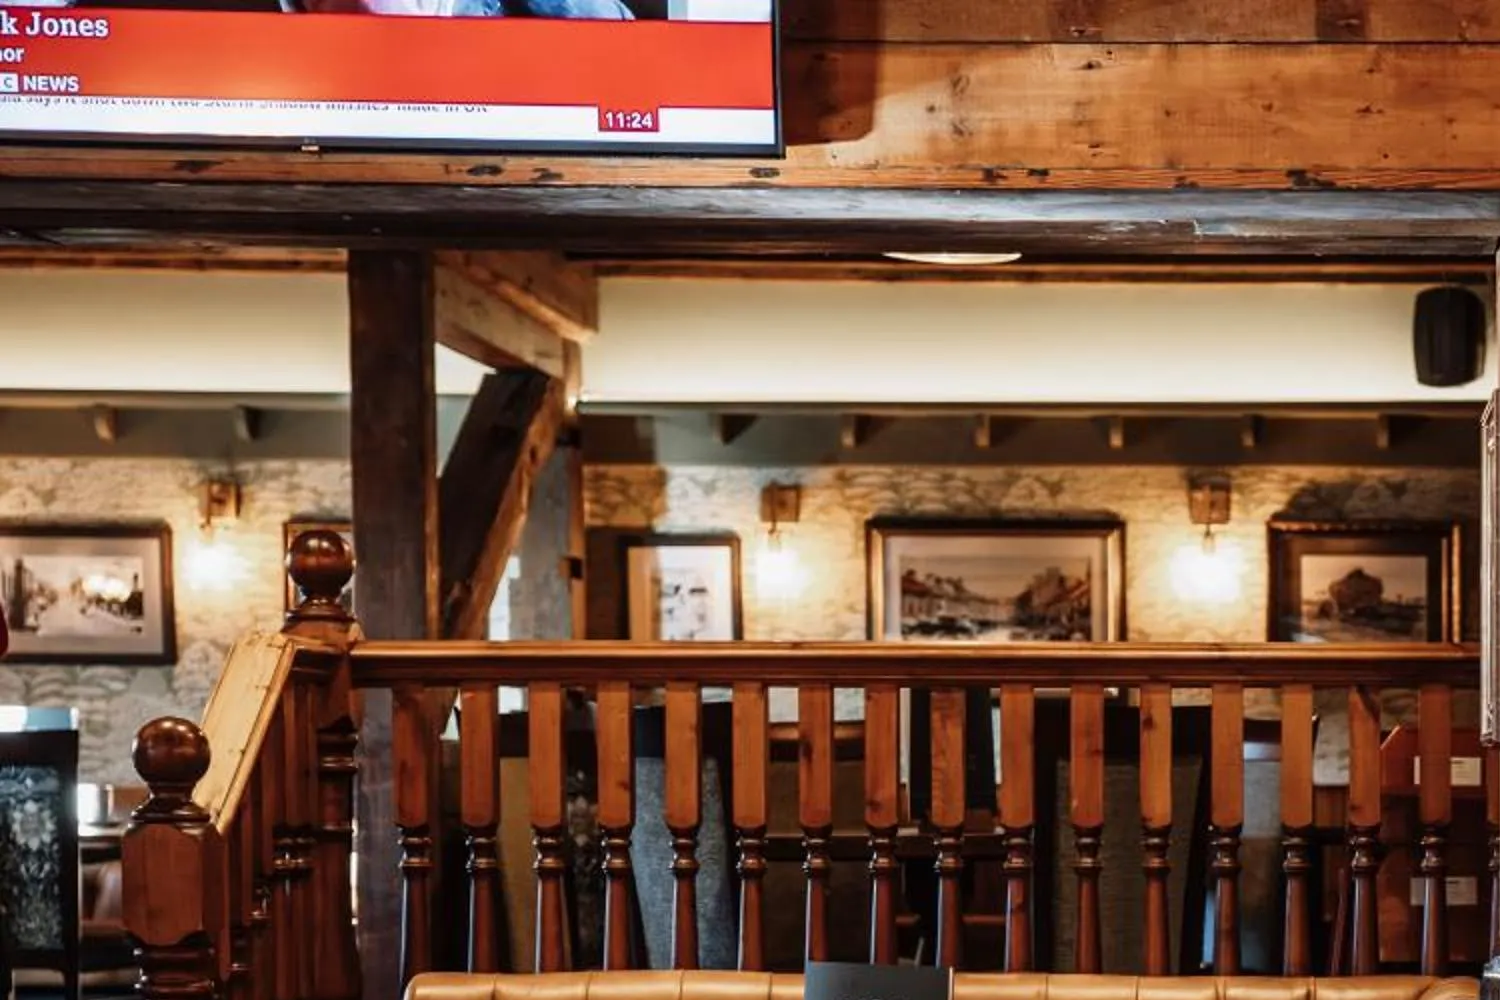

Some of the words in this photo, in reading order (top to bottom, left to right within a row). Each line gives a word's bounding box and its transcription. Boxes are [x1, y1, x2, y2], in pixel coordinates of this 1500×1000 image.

[25, 11, 109, 37] Jones
[23, 74, 80, 92] NEWS
[605, 111, 653, 129] 11:24
